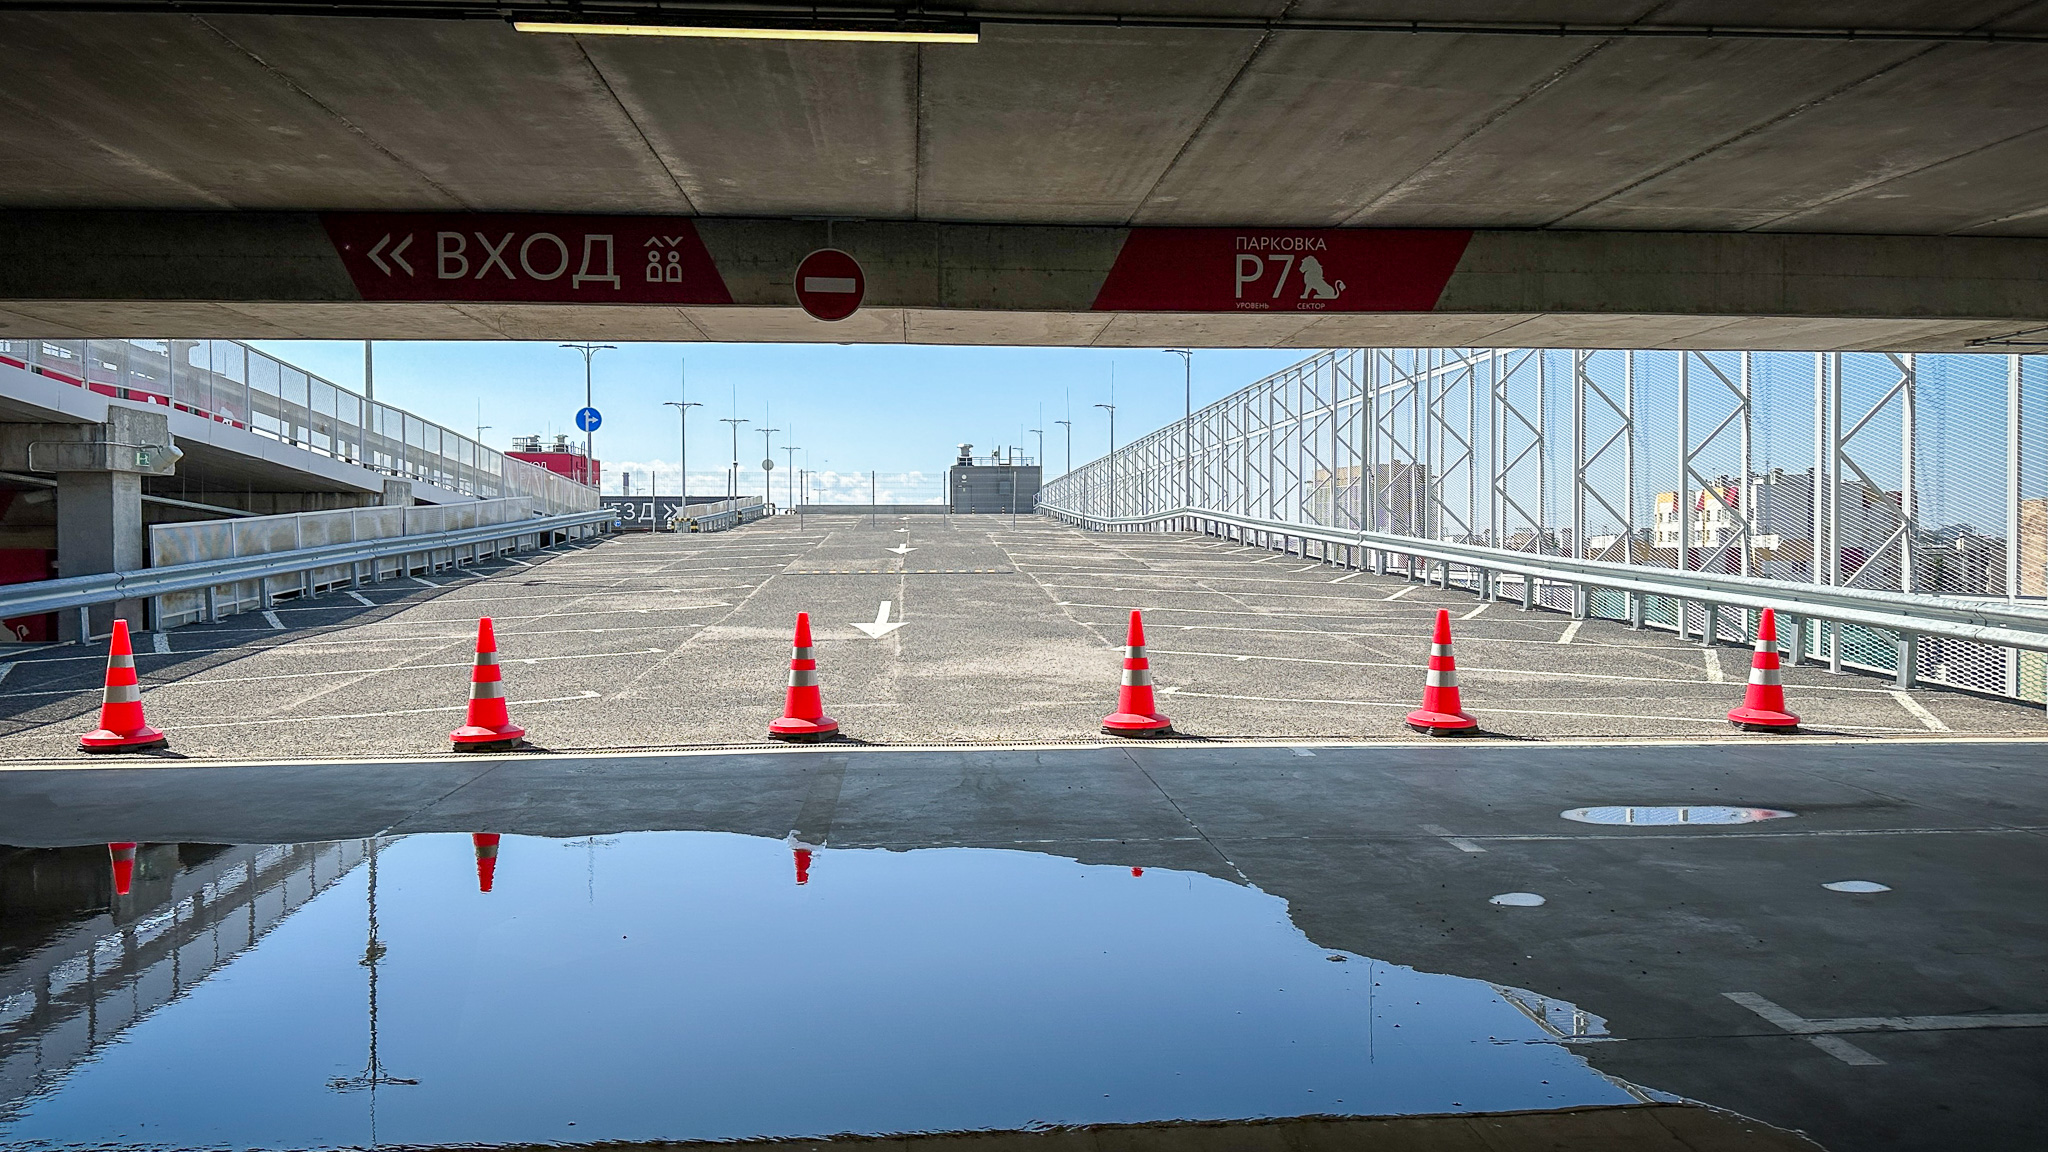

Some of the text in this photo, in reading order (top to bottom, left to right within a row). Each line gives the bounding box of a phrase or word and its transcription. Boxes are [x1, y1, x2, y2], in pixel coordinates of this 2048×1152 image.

[1237, 237, 1326, 250] ПАРКОВКА
[438, 232, 620, 289] ВХОД
[604, 502, 656, 523] ЕЗД
